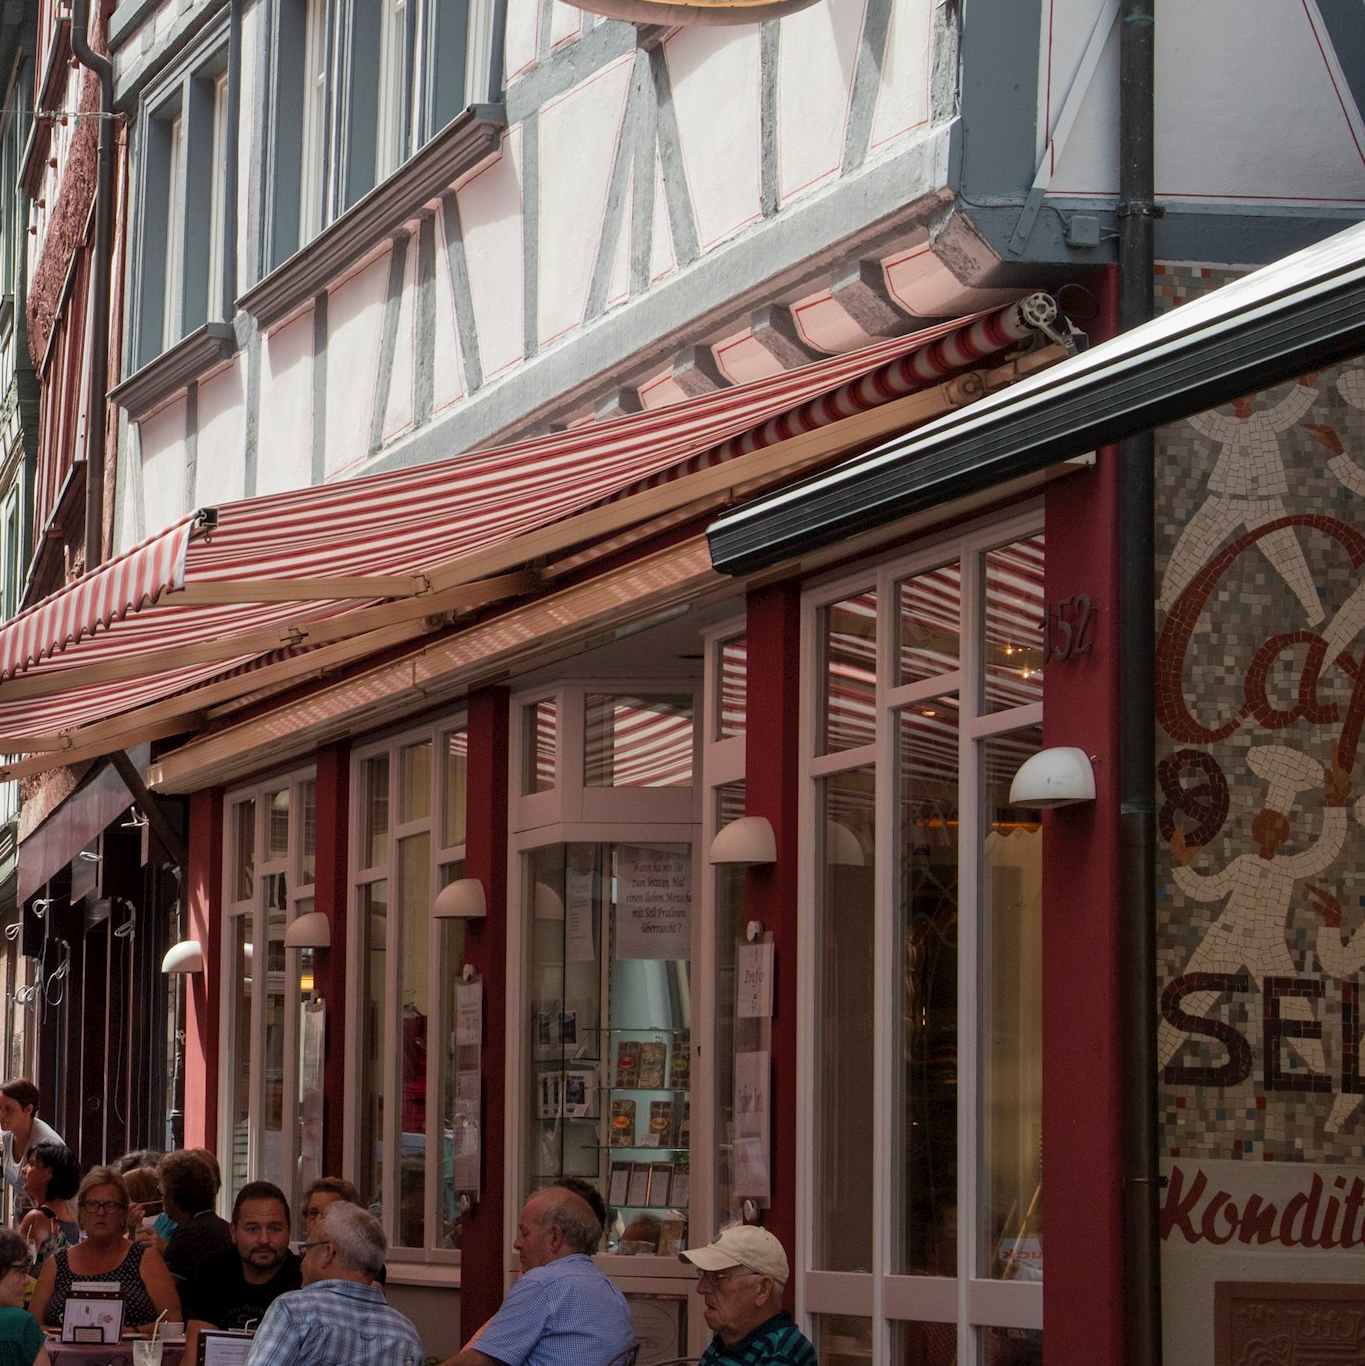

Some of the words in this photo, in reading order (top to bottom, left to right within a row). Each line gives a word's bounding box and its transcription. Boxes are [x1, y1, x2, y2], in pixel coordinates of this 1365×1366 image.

[1038, 592, 1095, 664] 152
[632, 907, 644, 918] mit
[645, 907, 656, 918] Sell
[658, 906, 686, 918] Pralinen
[744, 967, 765, 988] Info
